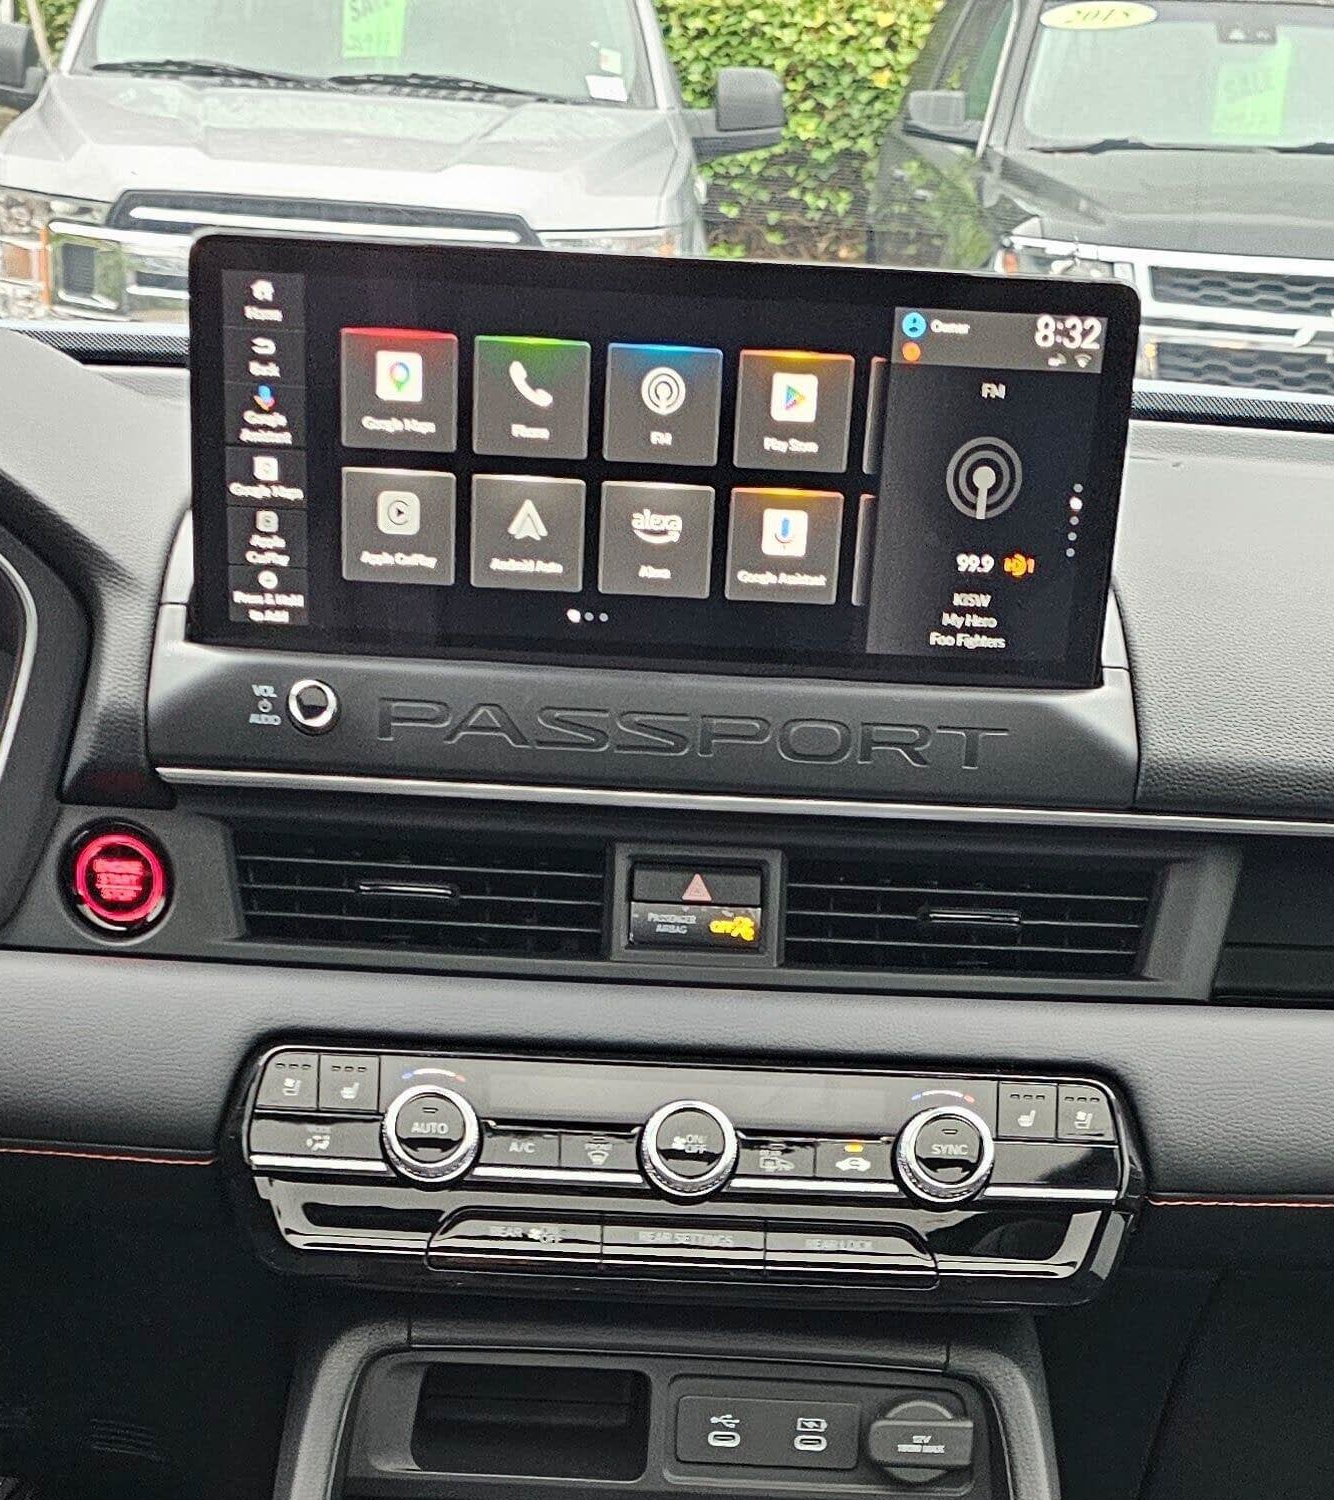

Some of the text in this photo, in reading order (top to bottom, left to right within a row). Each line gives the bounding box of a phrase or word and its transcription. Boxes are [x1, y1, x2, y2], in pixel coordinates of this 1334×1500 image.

[1034, 314, 1102, 349] 8:32
[980, 382, 1006, 399] FM
[650, 431, 672, 446] FM
[956, 553, 994, 572] 99.9
[737, 569, 777, 585] Google
[942, 611, 997, 628] My Hero
[929, 631, 1006, 649] Foo Fighters
[378, 698, 1009, 770] PASSPORT
[411, 1121, 449, 1135] AUTO
[508, 1142, 536, 1154] A/C
[931, 1143, 969, 1155] SYNC
